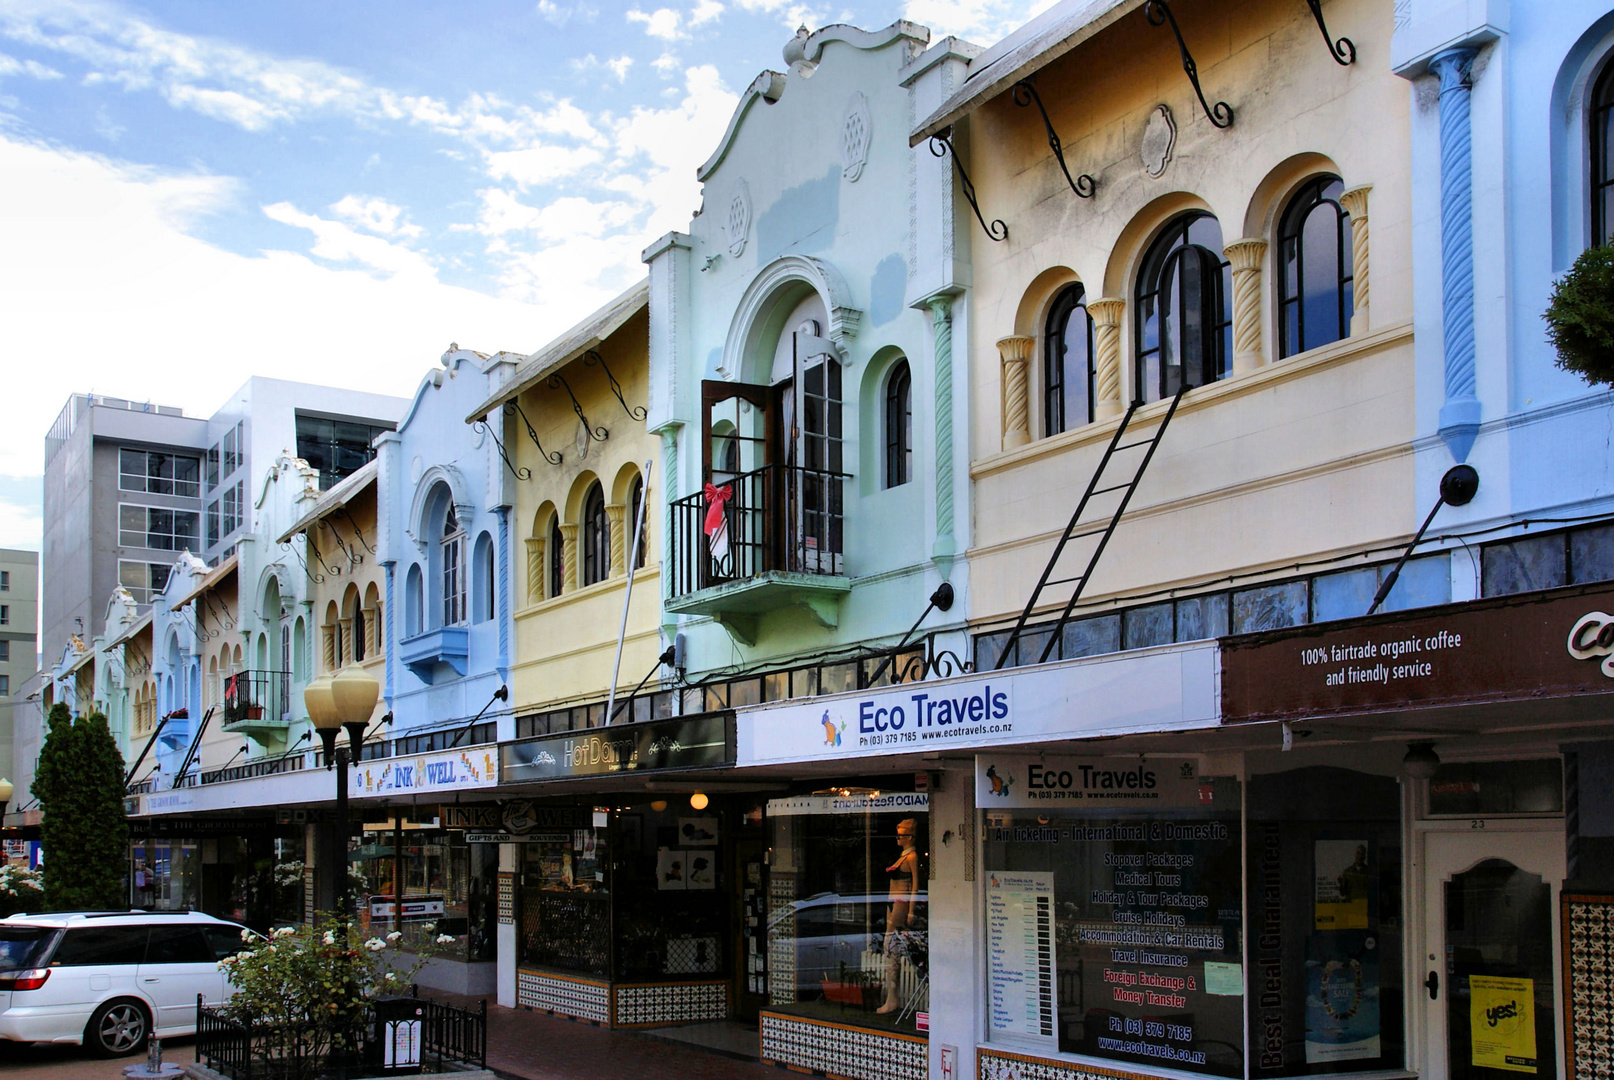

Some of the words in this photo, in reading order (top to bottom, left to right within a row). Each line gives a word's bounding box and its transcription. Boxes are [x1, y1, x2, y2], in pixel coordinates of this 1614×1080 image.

[1301, 647, 1328, 666] 100%
[1331, 640, 1377, 662] fairtrade
[1380, 634, 1422, 659] organic
[1425, 630, 1462, 651] coffee
[1326, 667, 1345, 686] and
[1348, 663, 1389, 685] friendly
[1392, 660, 1432, 679] service
[859, 701, 905, 734] Eco
[911, 685, 1009, 727] Travels
[859, 736, 868, 747] Ph
[870, 735, 883, 746] (03)
[885, 733, 898, 744] 379
[899, 732, 917, 743] 7185
[921, 723, 1012, 740] www.ecotravels.co.nz
[394, 763, 414, 788] INK
[427, 760, 457, 785] WELL
[1028, 764, 1073, 789] Eco
[1078, 765, 1156, 789] Travels
[1028, 791, 1037, 799] Ph
[1038, 791, 1052, 800] (03)
[1053, 791, 1066, 799] 379
[1067, 791, 1083, 799] 7185
[445, 807, 492, 827] INK
[539, 808, 592, 826] WELL
[1471, 820, 1485, 829] 23
[995, 827, 1010, 842] Air
[1014, 825, 1059, 844] ticketing
[1072, 823, 1146, 842] International
[1151, 824, 1161, 840] &
[1165, 821, 1227, 841] Domestic
[1104, 852, 1144, 868] Stopover
[1146, 852, 1193, 869] Packages
[1115, 871, 1152, 886] Medical
[1155, 872, 1181, 886] Tours
[1092, 890, 1125, 907] Holiday
[1127, 891, 1135, 904] &
[1138, 892, 1159, 905] Tour
[1160, 892, 1209, 909] Packages
[1113, 910, 1142, 924] Cruise
[1144, 911, 1185, 928] Holidays
[1080, 928, 1150, 944] Accommodation
[1154, 932, 1161, 945] &
[1165, 932, 1182, 946] Car
[1185, 934, 1224, 949] Rentals
[1111, 949, 1138, 963] Travel
[1140, 950, 1188, 967] Insurance
[1104, 968, 1136, 987] Foreign
[1139, 972, 1184, 991] Exchange
[1187, 976, 1196, 990] &
[1259, 958, 1282, 1008] Deal
[1114, 988, 1144, 1007] Money
[1146, 991, 1186, 1008] Transfer
[1486, 1000, 1518, 1028] yes!
[1109, 1016, 1122, 1031] Ph
[1124, 1017, 1143, 1036] (03)
[1145, 1021, 1165, 1038] 379
[1167, 1024, 1192, 1041] 7185
[1098, 1036, 1206, 1065] www.ecotravels.co.nz
[1260, 1015, 1283, 1069] Best
